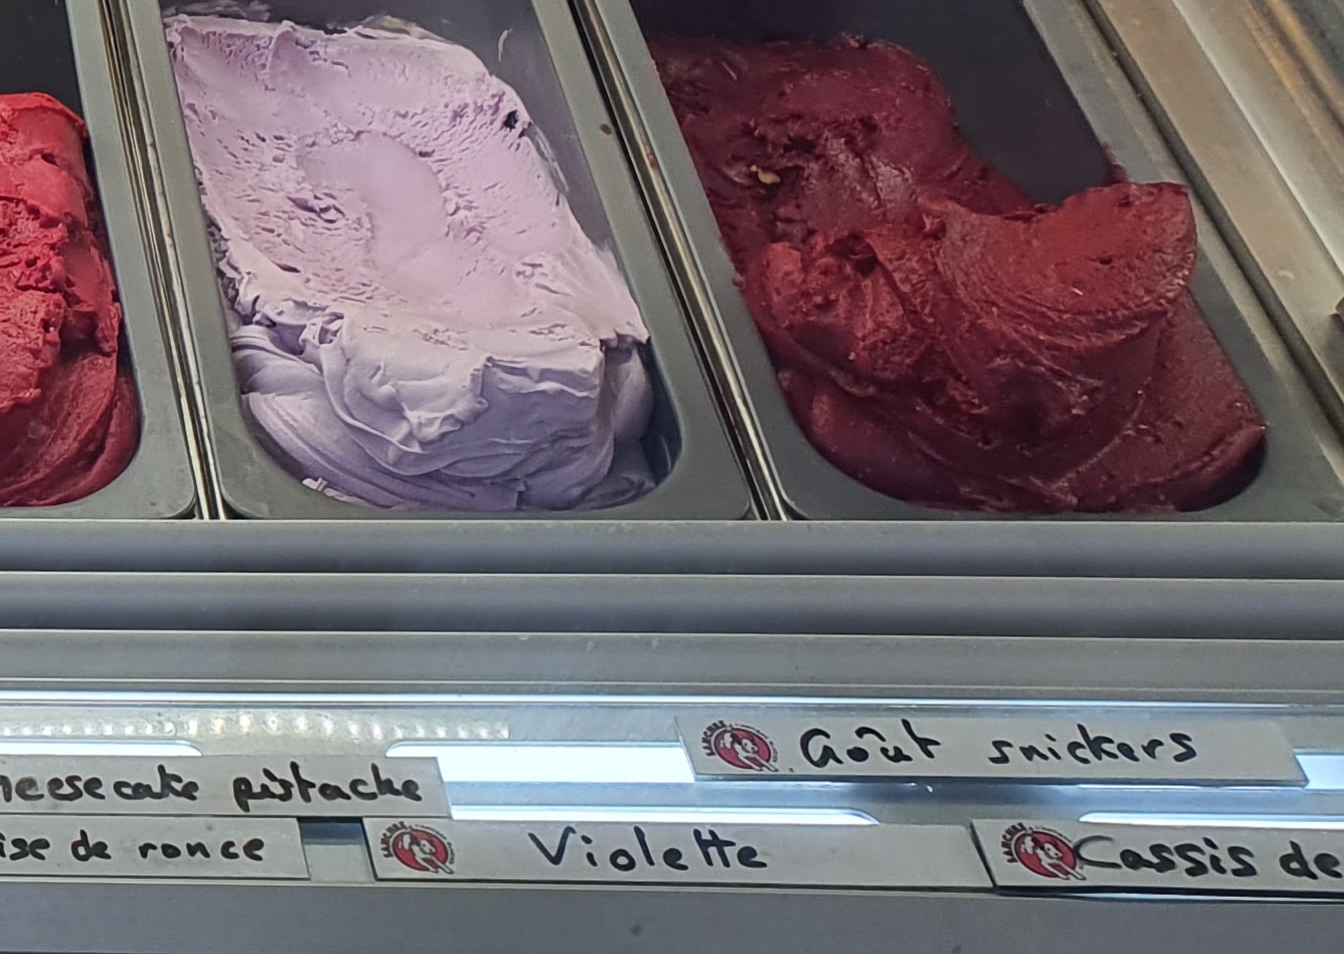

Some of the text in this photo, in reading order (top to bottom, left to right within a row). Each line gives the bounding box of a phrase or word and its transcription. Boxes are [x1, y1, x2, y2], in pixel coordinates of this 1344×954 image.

[799, 718, 942, 769] Goût
[987, 722, 1198, 765] snickers
[232, 760, 424, 813] pistache
[70, 828, 113, 863] de
[137, 837, 266, 863] ronce
[528, 825, 769, 873] Violette
[1073, 835, 1344, 882] Cassis de
